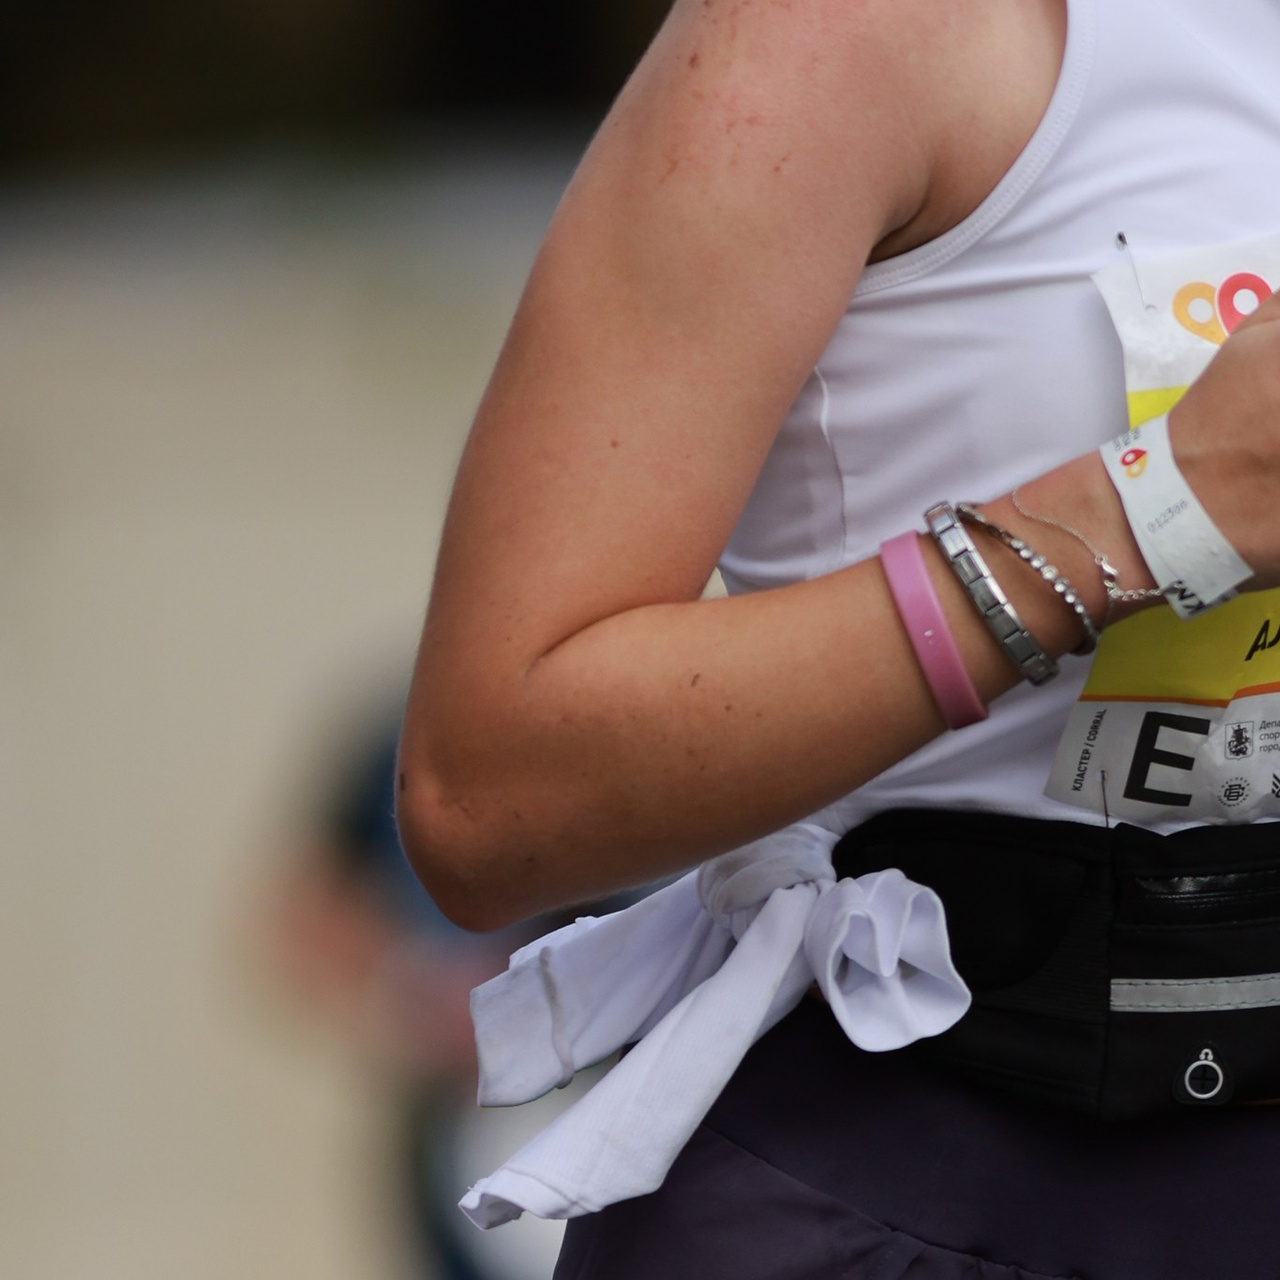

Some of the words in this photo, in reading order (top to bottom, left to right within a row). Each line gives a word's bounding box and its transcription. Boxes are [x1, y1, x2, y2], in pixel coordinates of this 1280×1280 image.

[1071, 747, 1092, 792] КЛАСТЕР
[1087, 708, 1108, 743] CORRAL
[1122, 710, 1212, 807] E
